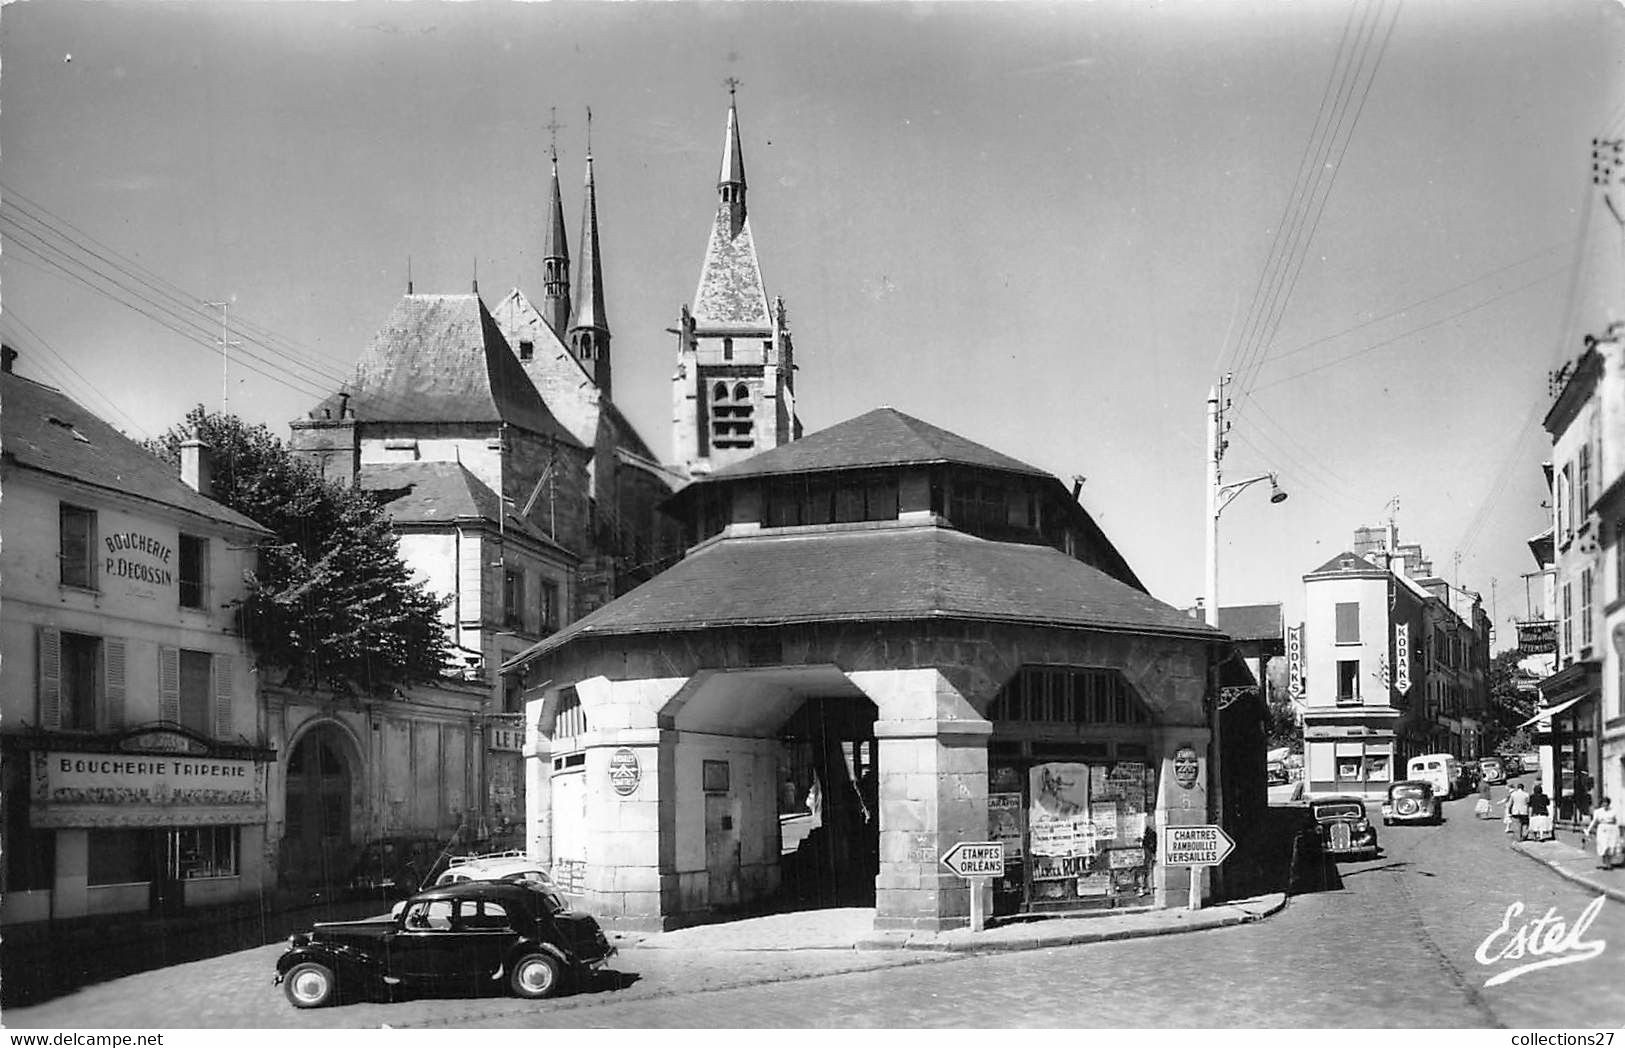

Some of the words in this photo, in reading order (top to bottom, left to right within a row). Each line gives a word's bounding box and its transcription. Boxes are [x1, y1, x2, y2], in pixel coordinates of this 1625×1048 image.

[105, 533, 171, 564] BOUCHERIE
[1290, 632, 1299, 693] KODAKS
[1398, 628, 1408, 689] KODAKS
[60, 758, 166, 775] BOUCHERIE
[172, 761, 246, 777] TRIPERIE
[1174, 830, 1217, 840] CHARTRES
[962, 848, 1000, 859] ETAMPES
[1172, 841, 1217, 851] RAMBOUILLET
[1167, 851, 1217, 862] VERSAILLES
